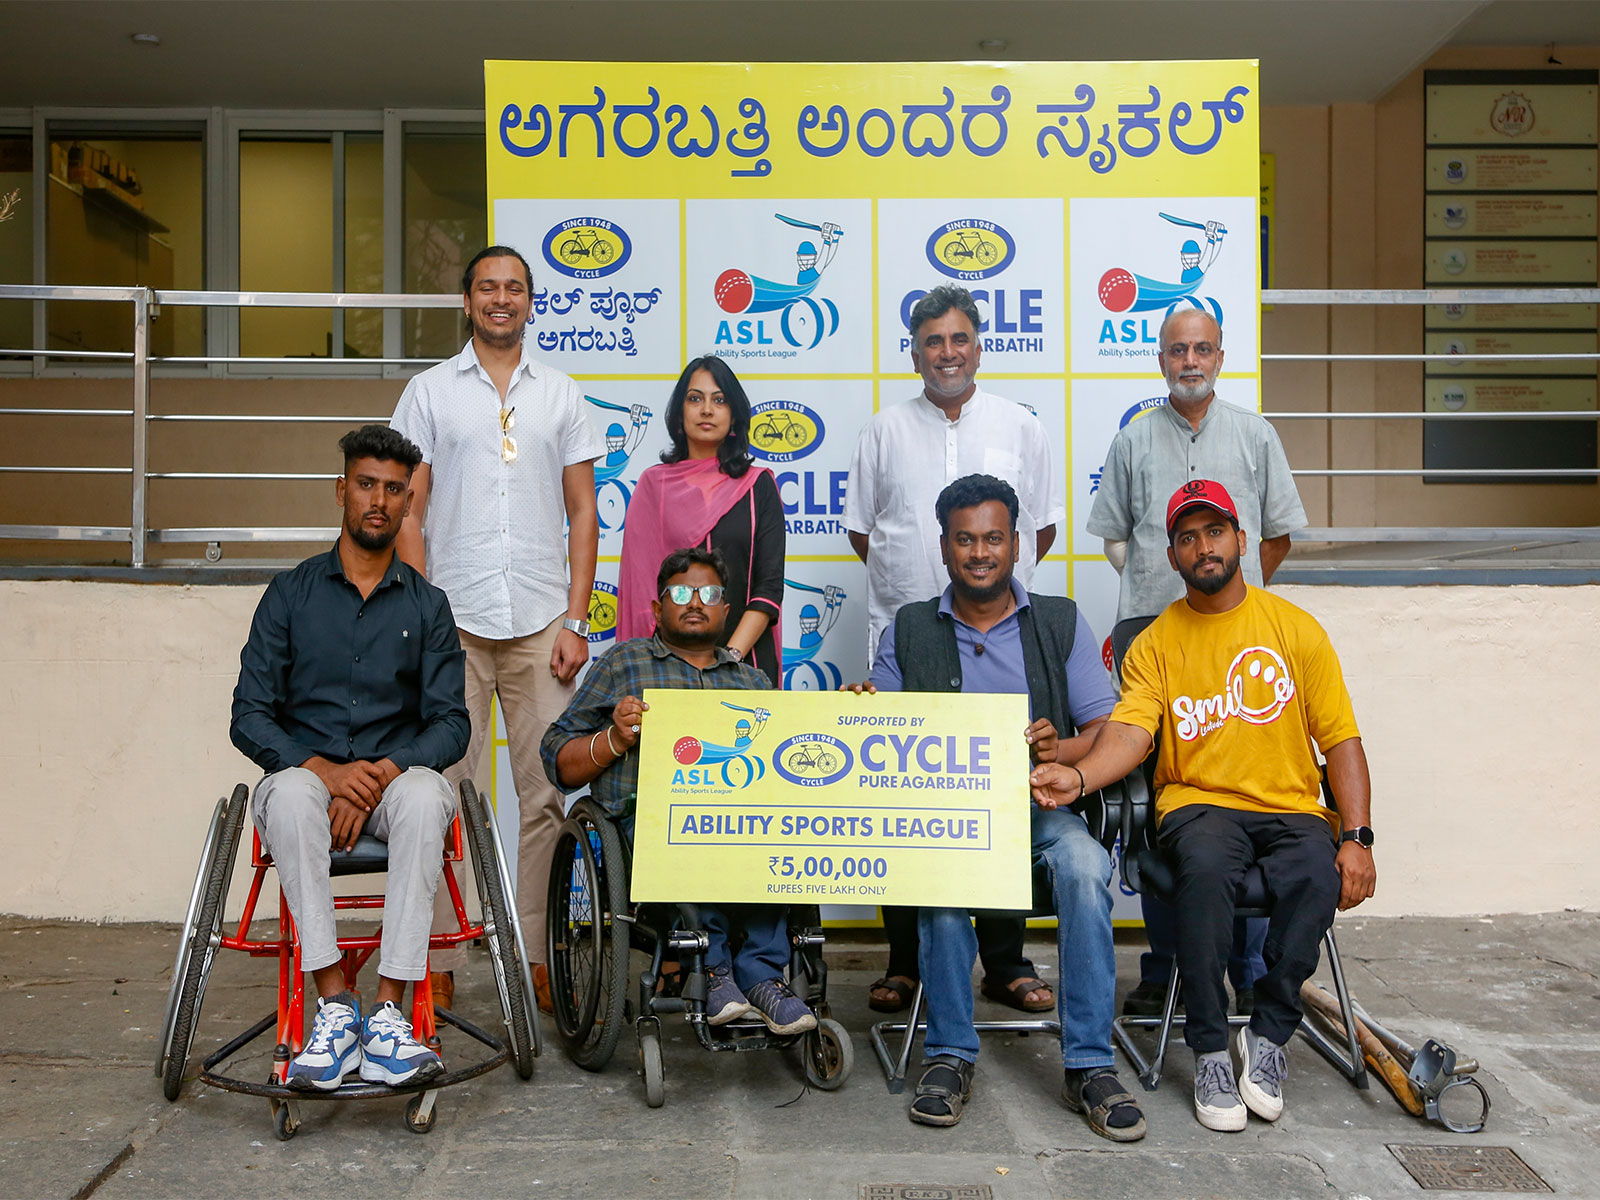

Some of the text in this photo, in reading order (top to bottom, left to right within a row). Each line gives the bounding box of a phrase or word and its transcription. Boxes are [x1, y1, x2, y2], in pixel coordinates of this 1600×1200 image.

[499, 83, 1250, 178] ಅಗರಬತ್ತಿ ಅಂದರೆ ಸೈಕಲ್
[562, 218, 612, 230] SINCE 1948
[946, 220, 996, 232] SINCE 1948
[574, 269, 600, 279] CYCLE
[957, 271, 984, 280] CYCLE
[714, 320, 773, 345] ASL
[1098, 319, 1157, 344] ASL
[537, 325, 638, 357] ಅಗರಬತ್ತಿ
[714, 349, 797, 359] Ability Sports League
[1098, 348, 1123, 358] Ability
[1124, 348, 1150, 358] Sports
[755, 401, 805, 414] SINCE 1948
[1139, 398, 1165, 411] SINCE
[767, 453, 793, 462] CYCLE
[776, 471, 849, 515] CLE
[837, 715, 926, 727] SUPPORTED BY
[791, 734, 836, 745] SINCE 1948
[860, 734, 991, 775] CYCLE
[671, 769, 715, 785] ASL
[800, 778, 824, 786] CYCLE
[859, 775, 991, 791] PURE AGARBATHI
[670, 787, 689, 795] Ability
[690, 787, 710, 795] Sports
[680, 814, 979, 839] ABILITY SPORTS LEAGUE
[768, 856, 888, 881] ₹5,00,000
[767, 883, 887, 895] RUPEES FIVE LAKH ONLY
